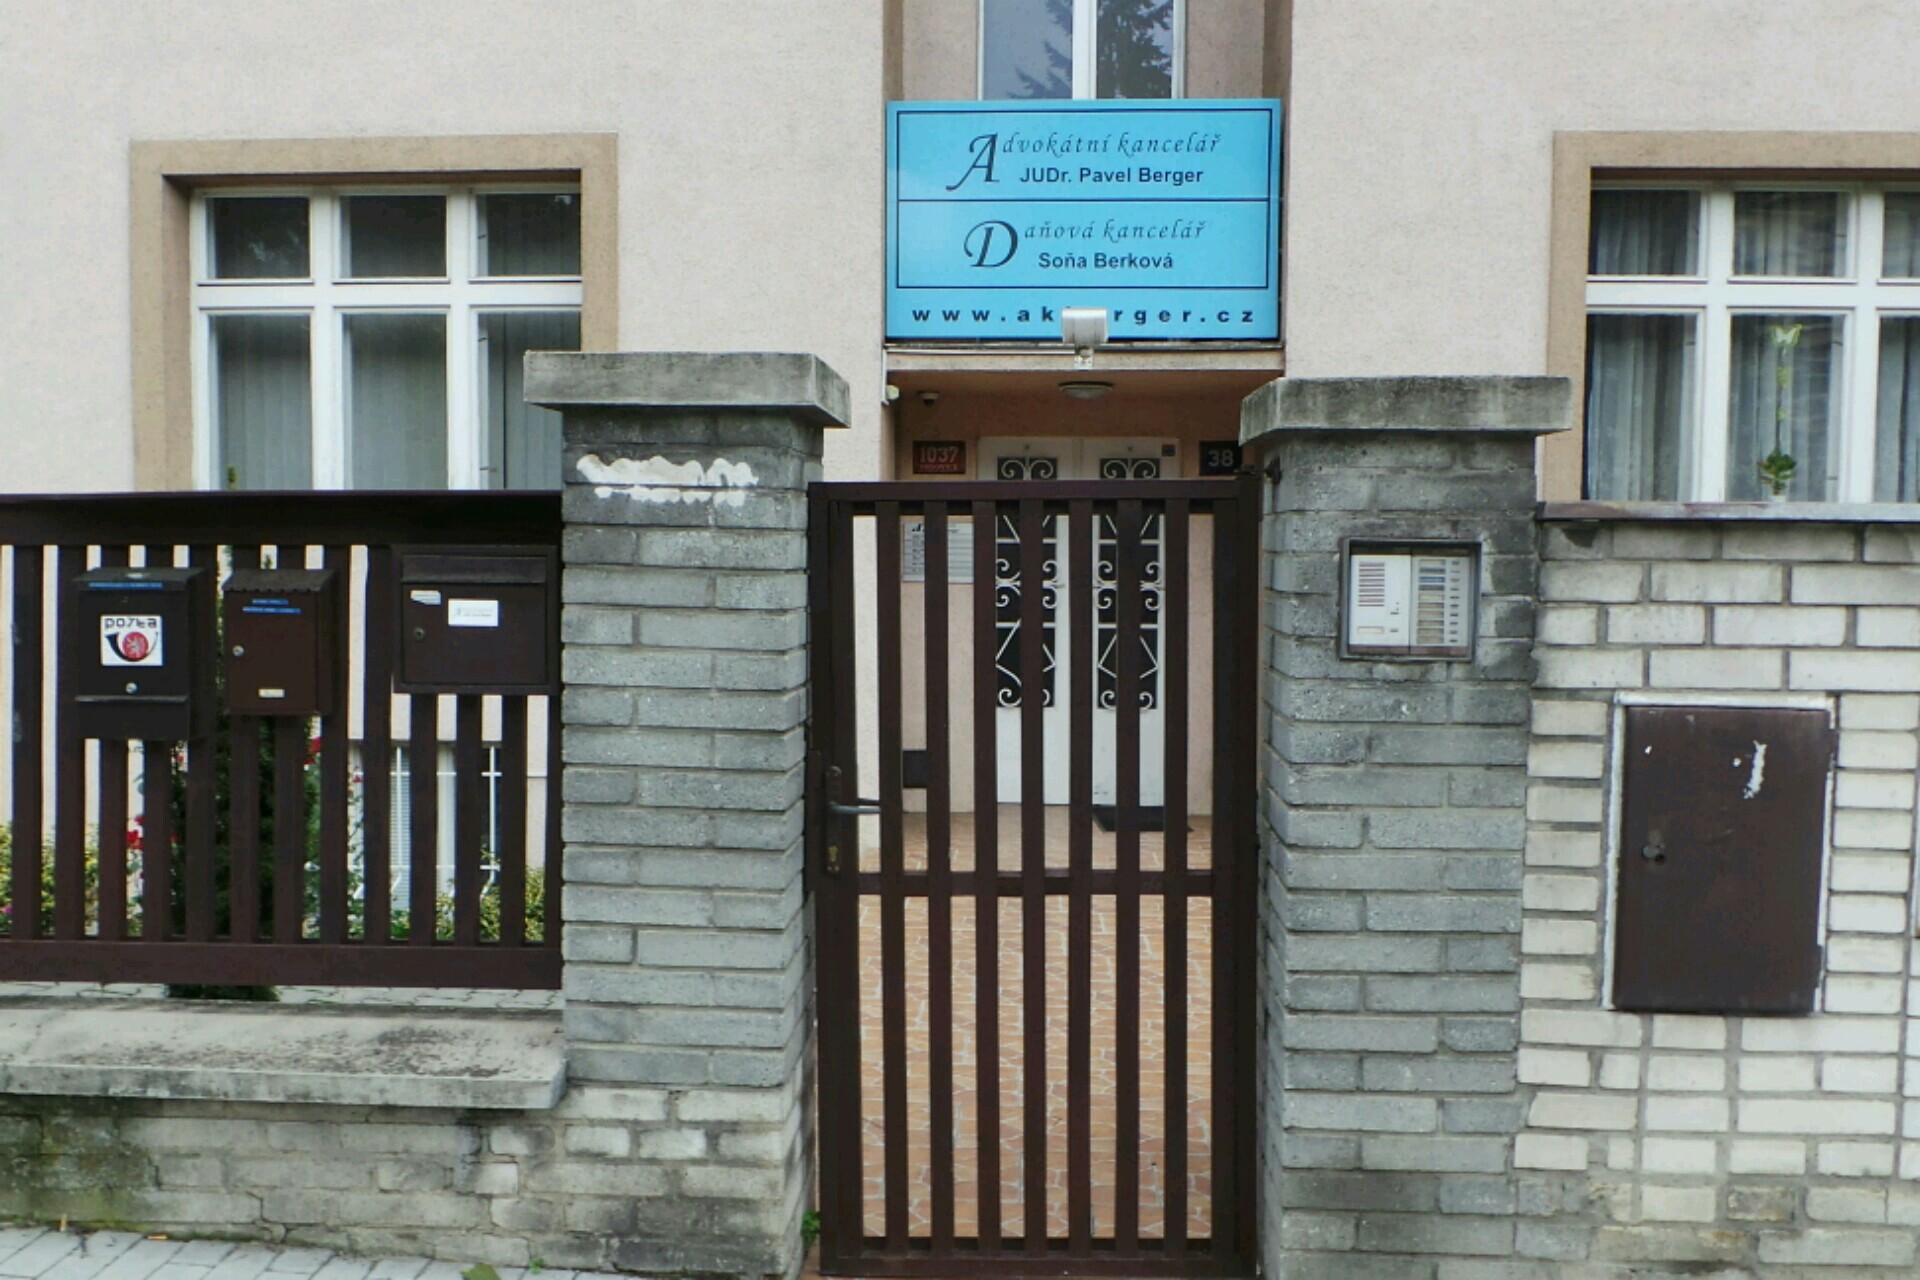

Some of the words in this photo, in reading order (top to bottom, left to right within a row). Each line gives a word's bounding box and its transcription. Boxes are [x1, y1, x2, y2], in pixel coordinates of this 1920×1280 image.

[946, 132, 1111, 191] Advokátní
[1118, 132, 1221, 158] kancelář
[1020, 167, 1072, 183] JUDr.
[1080, 167, 1131, 182] Pavel
[1138, 167, 1204, 186] Berger
[964, 220, 1095, 268] Daňová
[1103, 218, 1206, 243] kancelář
[1039, 252, 1087, 268] Soňa
[1094, 252, 1174, 269] Berková
[912, 305, 1253, 325] www.akrger.cz
[920, 446, 958, 463] 1037
[1207, 449, 1233, 467] 38
